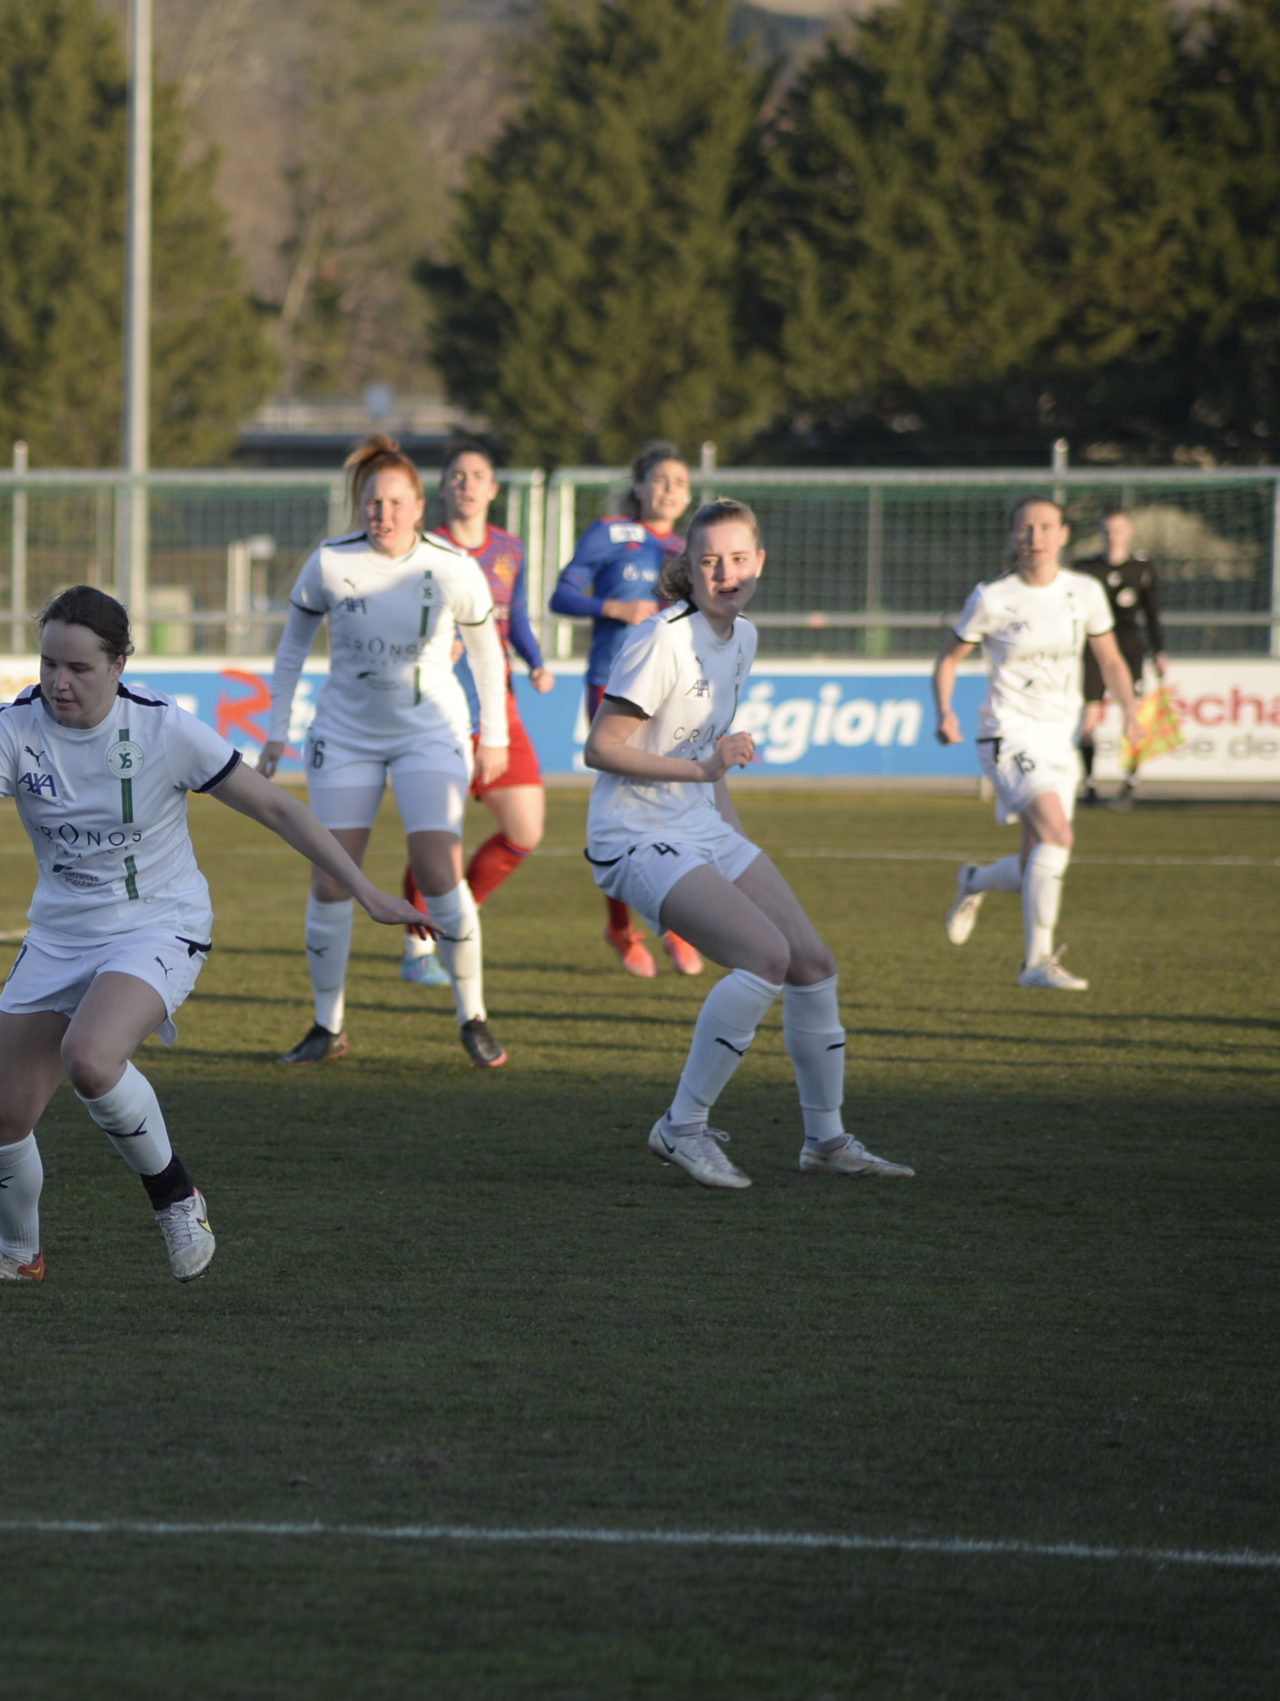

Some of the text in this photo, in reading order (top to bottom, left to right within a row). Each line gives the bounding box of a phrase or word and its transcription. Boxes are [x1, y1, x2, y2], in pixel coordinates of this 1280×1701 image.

[730, 682, 922, 765] égion
[18, 772, 57, 797] AXA
[35, 822, 142, 847] RONOS
